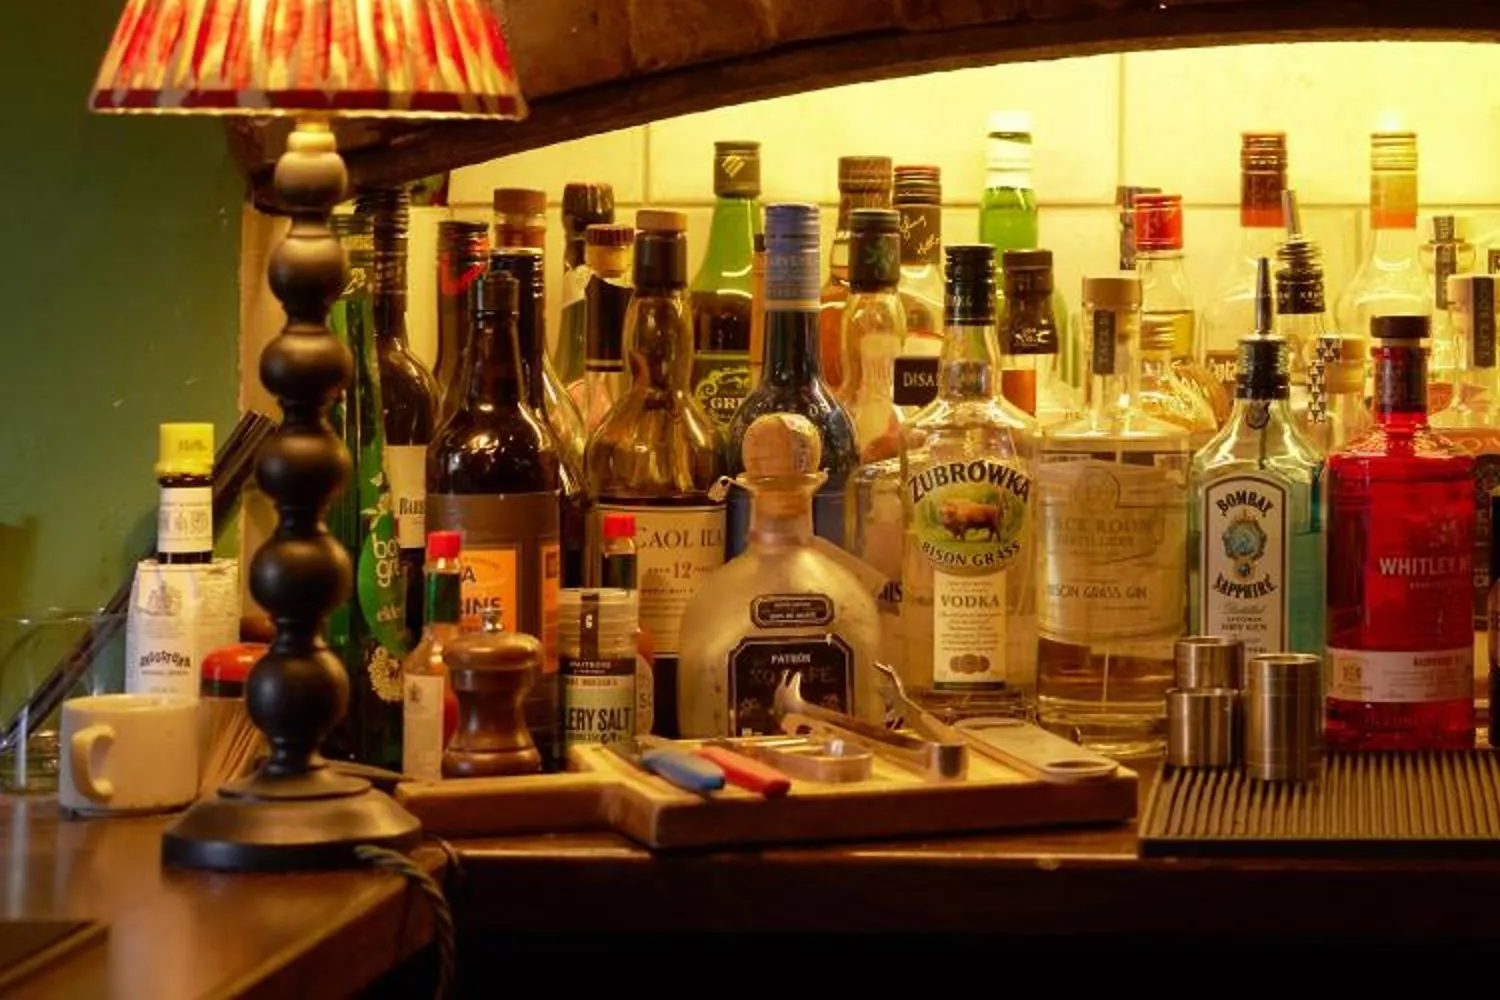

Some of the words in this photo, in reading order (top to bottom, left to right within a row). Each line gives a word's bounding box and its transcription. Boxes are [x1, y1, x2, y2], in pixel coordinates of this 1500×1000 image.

[1216, 489, 1274, 517] BOMBAY
[922, 541, 967, 567] BISON
[972, 541, 1022, 567] GRASS
[674, 562, 692, 579] 12
[1213, 573, 1279, 600] SAPPHIRE
[940, 594, 1000, 609] VODKA
[598, 706, 633, 732] SALT
